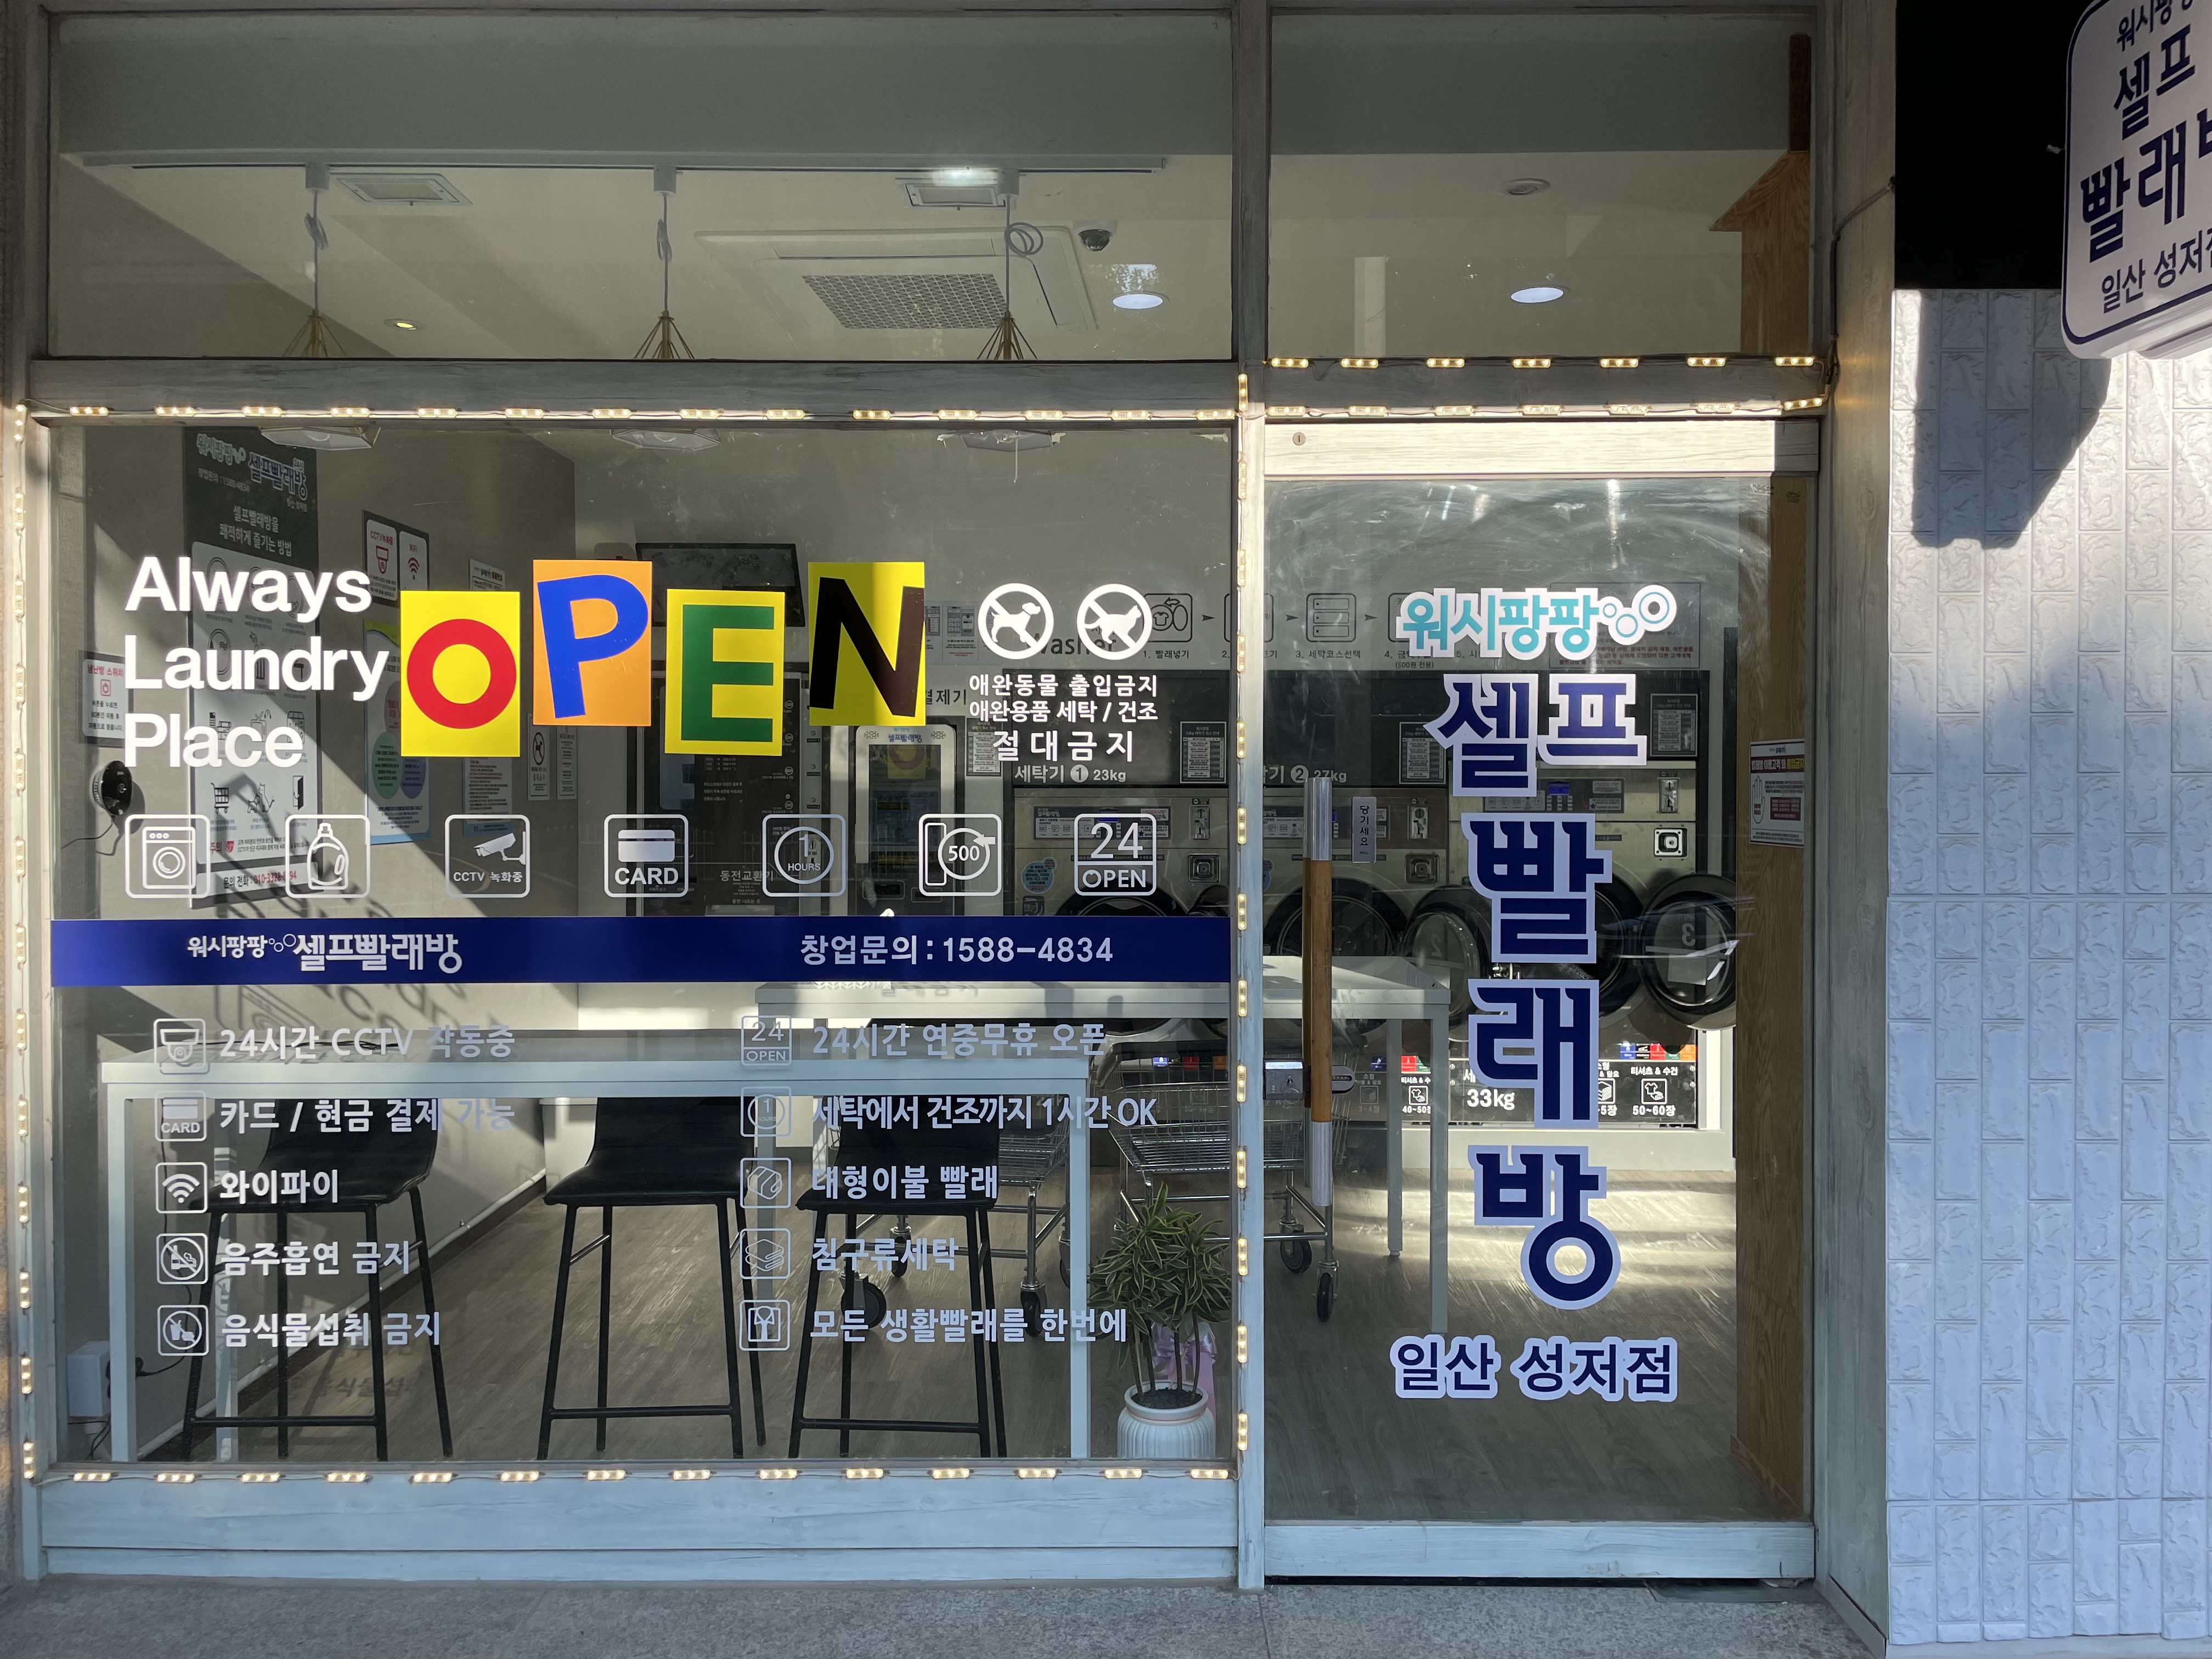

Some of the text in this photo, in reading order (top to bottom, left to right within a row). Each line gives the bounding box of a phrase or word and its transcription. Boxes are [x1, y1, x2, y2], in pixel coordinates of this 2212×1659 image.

[2113, 24, 2196, 140] 셀프
[2101, 258, 2146, 314] 일산
[248, 451, 307, 500] 셀프빨래방
[233, 505, 279, 533] 셀프빨래방을
[219, 523, 292, 557] 쾌적하게 즐기는 방법
[125, 555, 371, 623] Always
[1028, 627, 1116, 655] asher
[1399, 591, 1600, 657] 워시팡팡
[88, 664, 123, 678] 냉난방 스위치
[125, 635, 390, 701] Laundry
[407, 574, 924, 742] OPEN
[1155, 649, 1189, 659] 빨래넣기
[1308, 650, 1361, 659] 세탁코스선택
[969, 674, 1158, 697] 애완동물 출입금지
[969, 700, 1051, 723] 애완용품
[1057, 701, 1097, 723] 세탁
[1118, 701, 1158, 722] 건조
[125, 713, 303, 768] Place
[888, 733, 922, 743] 셀프빨래방
[1432, 678, 1642, 793] 셀프
[1014, 764, 1127, 783] 세탁기 23kg
[1090, 822, 1144, 859] 24
[1359, 805, 1370, 846] 당기세요
[799, 833, 809, 857] 1
[949, 845, 980, 861] 500
[223, 871, 297, 889] 문의 전화 010-3328-894
[453, 871, 523, 884] CCTV 녹화중
[614, 867, 679, 885] CARD
[720, 870, 774, 882] 동전교환기
[787, 862, 821, 871] HOURS
[1082, 869, 1147, 888] OPEN
[187, 933, 463, 974] 워시팡팡 셀프빨래방
[220, 1024, 516, 1060] 24시간 CCTV 작동중
[751, 1020, 785, 1041] 24
[813, 1022, 1108, 1057] 24시간 연중무휴 오픈
[746, 1050, 786, 1062] OPEN
[1630, 1066, 1654, 1076] 티셔츠
[1663, 1066, 1678, 1076] 수건
[220, 1100, 280, 1134] 카드
[314, 1099, 374, 1133] 현금
[386, 1098, 443, 1133] 결제
[457, 1098, 516, 1131] 가능
[812, 1095, 1159, 1130] 세탁에서 건조까지 1시간 OK
[1466, 1088, 1515, 1110] 33kg
[1632, 1104, 1676, 1116] 50~60장
[161, 1121, 200, 1134] CARD
[219, 1169, 338, 1204] 와이파이
[812, 1165, 999, 1200] 대형이불 빨래
[221, 1240, 410, 1276] 음주흡연 금지
[812, 1237, 960, 1272] 침구류세탁
[221, 1311, 441, 1348] 음식물섭취 금지
[810, 1308, 1127, 1343] 모든 생활빨래를 한번에
[1395, 1340, 1673, 1397] 일산 성저점
